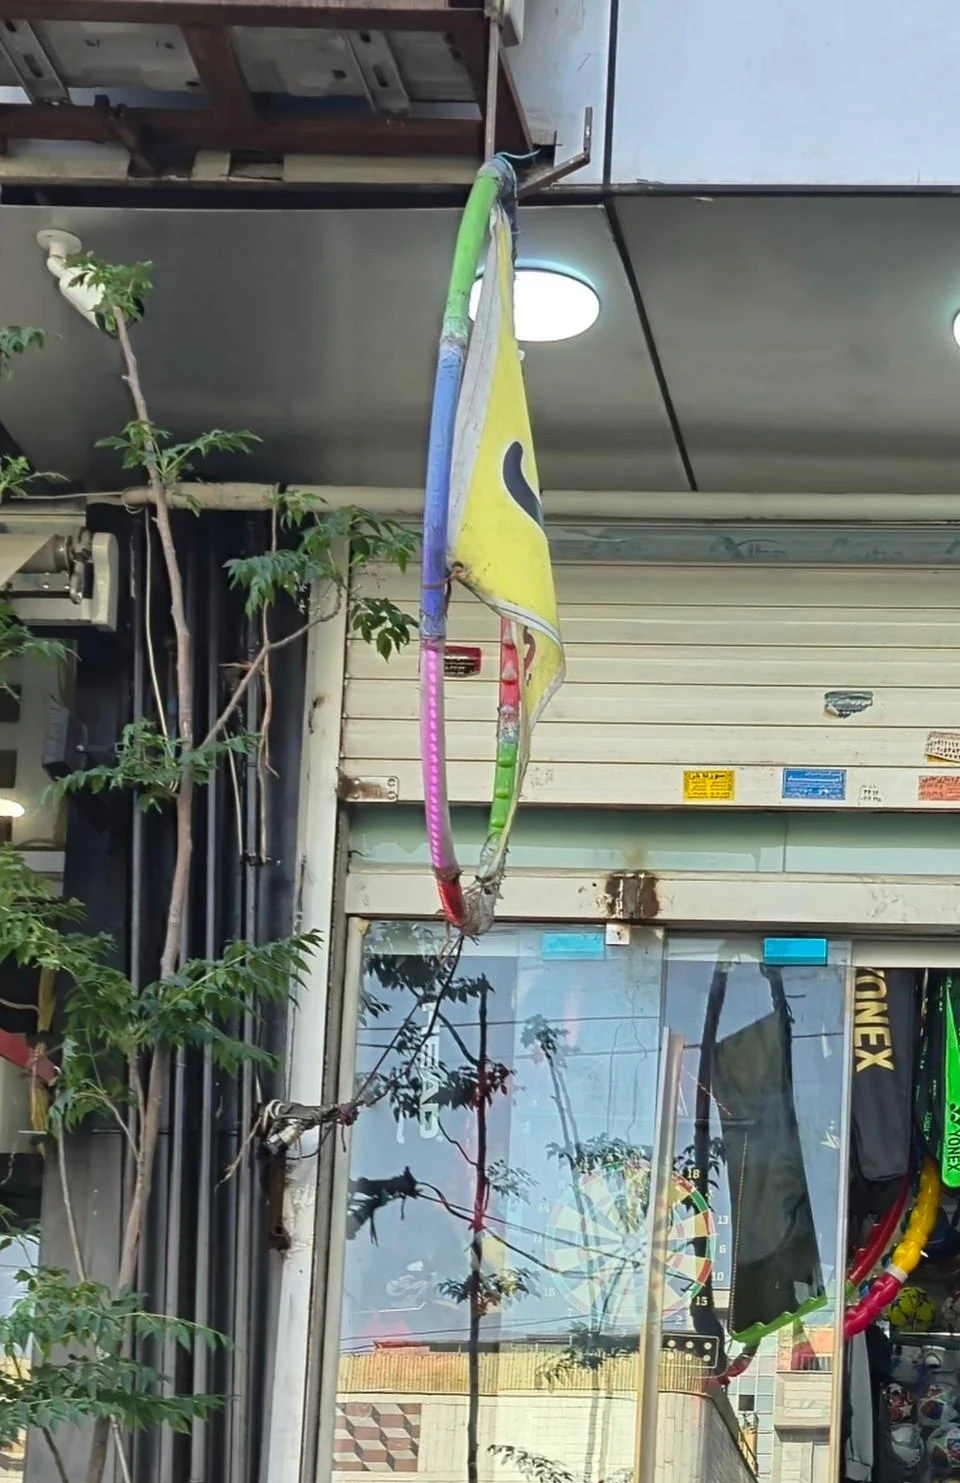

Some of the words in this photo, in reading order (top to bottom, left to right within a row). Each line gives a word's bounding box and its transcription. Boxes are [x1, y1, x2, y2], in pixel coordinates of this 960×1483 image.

[947, 1130, 960, 1173] YONEX
[686, 1168, 700, 1179] 18
[717, 1215, 729, 1225] 13
[696, 1295, 708, 1307] 15
